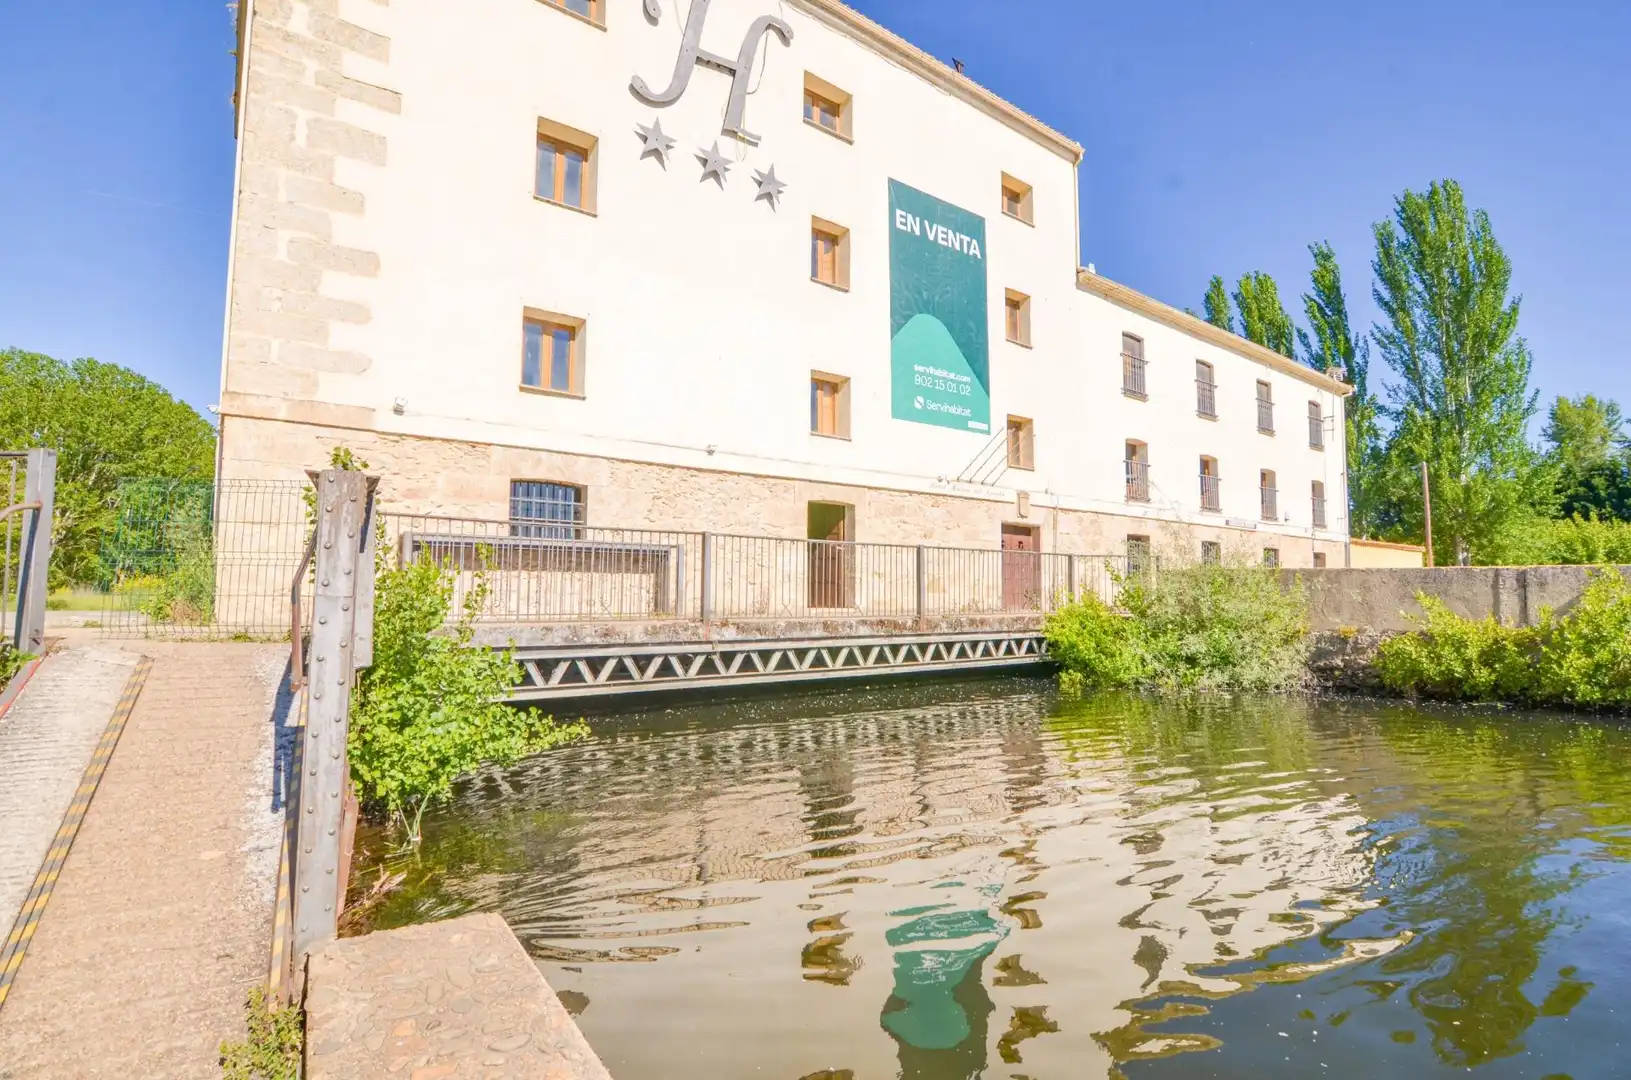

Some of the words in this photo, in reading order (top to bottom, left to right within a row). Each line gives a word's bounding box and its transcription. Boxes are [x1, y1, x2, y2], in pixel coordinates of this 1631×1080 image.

[895, 208, 921, 237] EN
[924, 219, 982, 259] VENTA
[913, 364, 971, 383] servihabitat.com
[914, 374, 933, 388] 902
[934, 379, 946, 391] 15
[946, 381, 958, 393] 01
[959, 384, 972, 396] 02
[926, 399, 972, 417] Servihabitat
